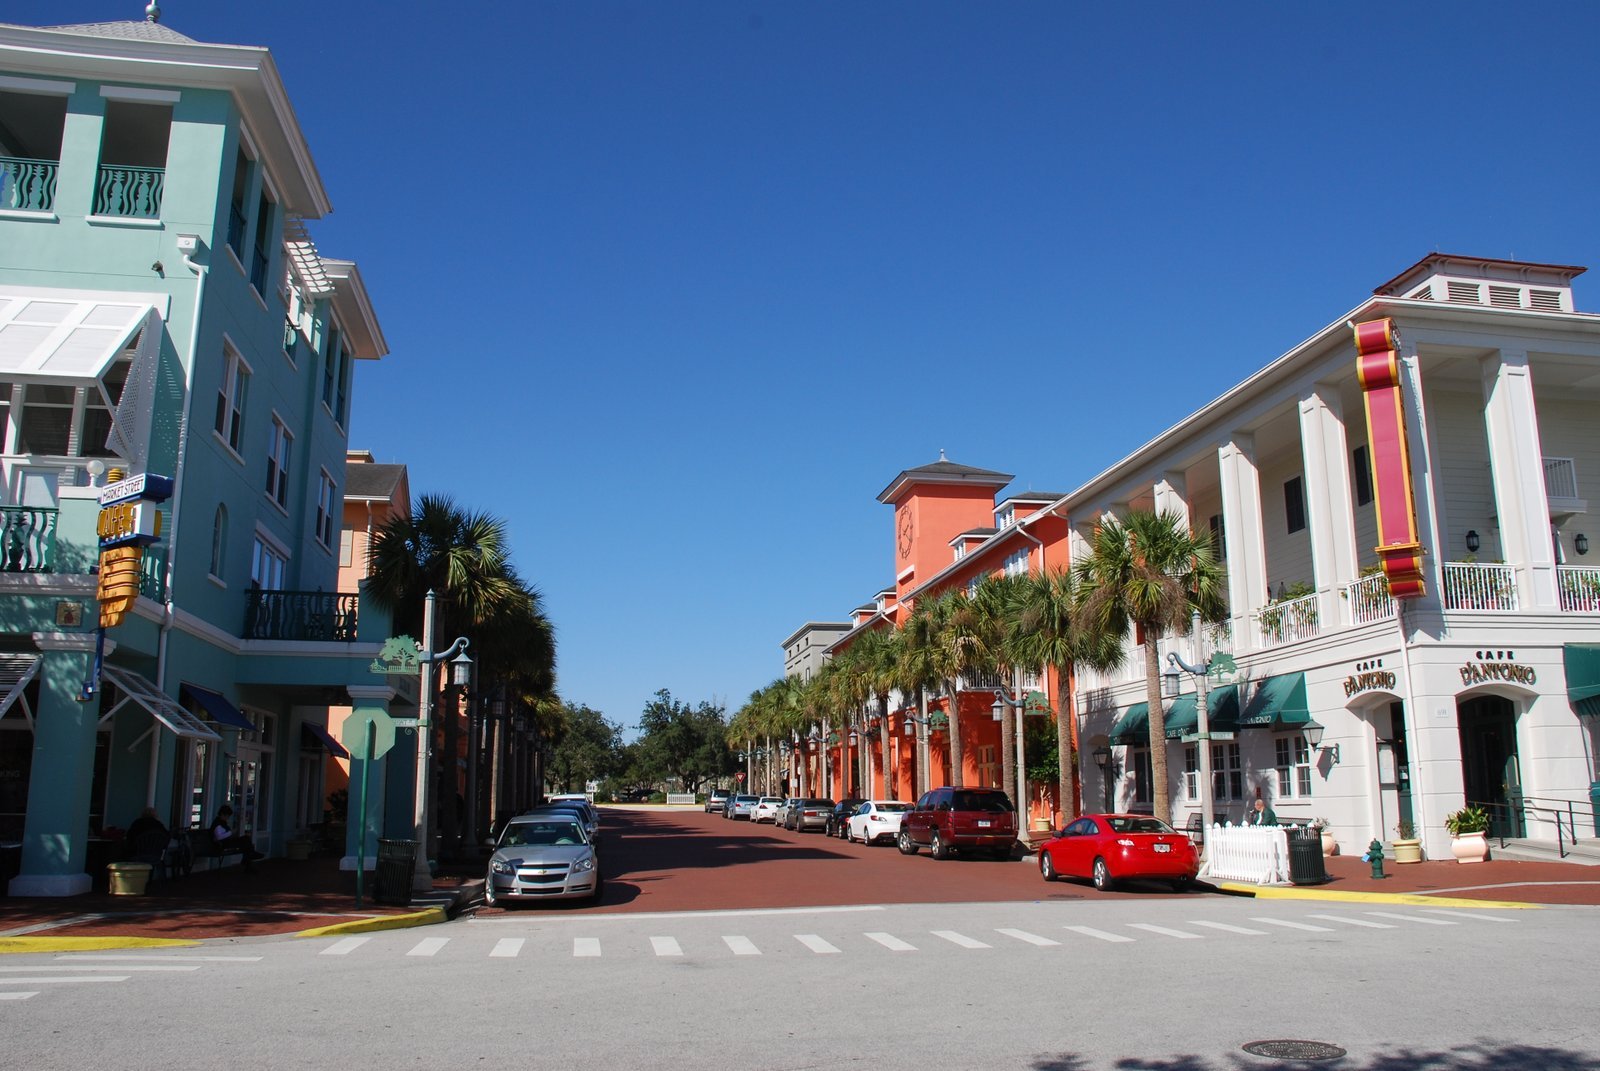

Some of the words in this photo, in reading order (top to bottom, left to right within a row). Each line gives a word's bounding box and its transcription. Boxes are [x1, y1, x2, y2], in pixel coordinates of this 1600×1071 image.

[103, 485, 124, 500] MARKET
[124, 478, 144, 495] STREET
[97, 503, 125, 538] CAFE
[1356, 659, 1383, 672] CAFE
[1476, 650, 1514, 661] CAFE
[1343, 671, 1396, 699] D'ANTONIO
[1459, 661, 1537, 687] D'ANTONIO
